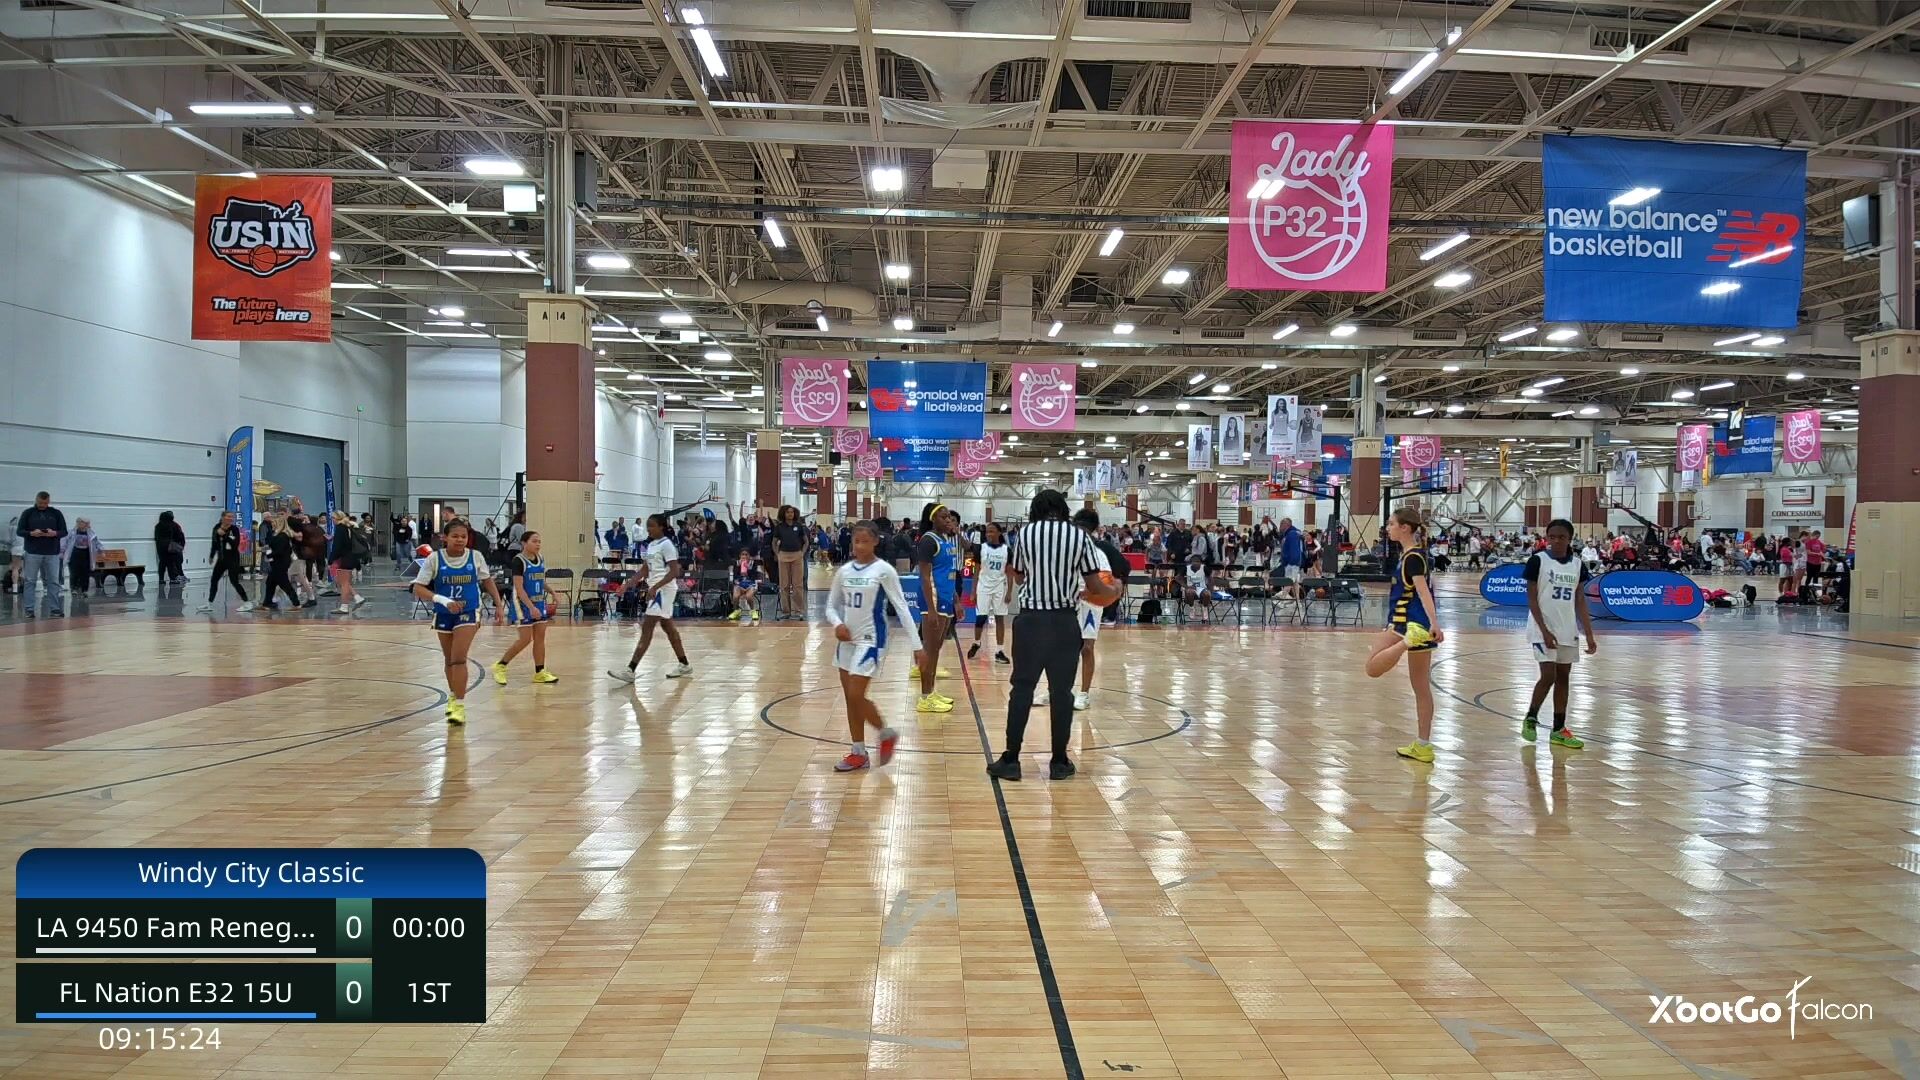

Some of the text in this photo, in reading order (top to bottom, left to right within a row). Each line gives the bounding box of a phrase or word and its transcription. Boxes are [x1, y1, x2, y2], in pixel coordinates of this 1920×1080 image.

[1257, 131, 1371, 190] Lady
[1263, 205, 1327, 237] P32
[1548, 207, 1603, 228] new
[1609, 205, 1718, 233] balance
[214, 221, 310, 249] USJN
[1549, 232, 1682, 259] basketball
[212, 298, 276, 310] The future
[234, 309, 310, 324] plays here
[542, 311, 566, 321] A 14
[989, 560, 1002, 571] 20
[449, 585, 463, 599] 12
[1551, 586, 1573, 601] 35
[1603, 585, 1661, 595] new balance
[1607, 595, 1654, 606] basketball
